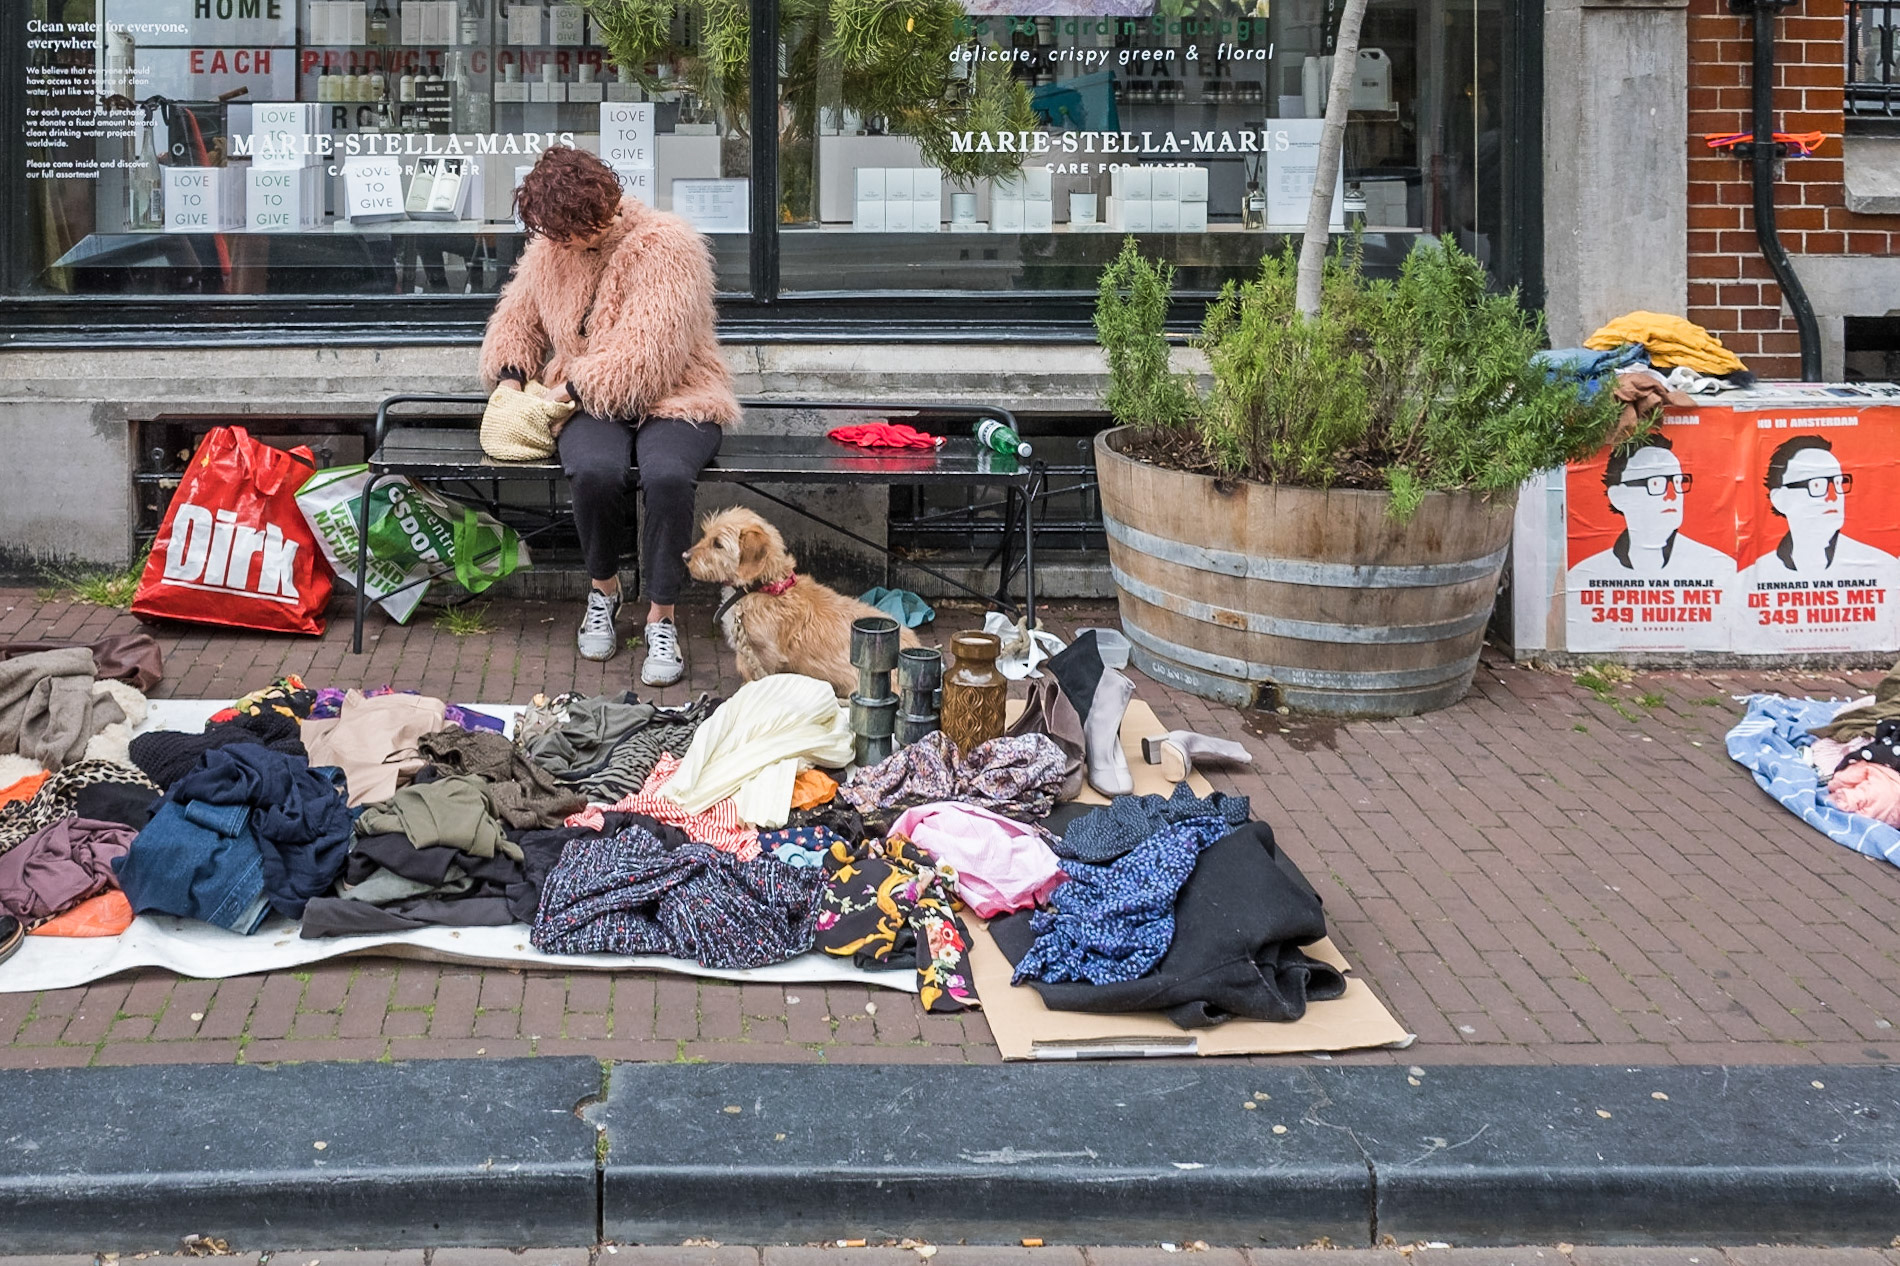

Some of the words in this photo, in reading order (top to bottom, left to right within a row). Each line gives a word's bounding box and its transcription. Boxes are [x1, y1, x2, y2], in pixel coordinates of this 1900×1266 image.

[195, 0, 281, 19] HOME
[27, 20, 63, 32] Clean
[67, 21, 102, 32] water
[105, 20, 124, 32] for
[127, 22, 188, 37] everyone,
[1005, 16, 1037, 36] 96
[1051, 14, 1136, 36] Jardin
[1152, 15, 1266, 41] Sauvage
[27, 37, 103, 52] everywhere.
[949, 45, 1037, 64] delicate,
[1049, 46, 1109, 65] crispy
[1119, 49, 1175, 65] green
[1186, 45, 1199, 61] &
[1217, 43, 1274, 61] floral
[190, 50, 271, 74] EACH
[302, 50, 441, 74] PRODUCT
[26, 66, 39, 74] We
[42, 66, 68, 74] believe
[71, 66, 86, 74] that
[88, 68, 122, 77] everyone
[125, 66, 150, 74] should
[26, 77, 45, 85] have
[74, 77, 82, 85] to
[118, 77, 127, 85] of
[129, 77, 149, 85] clean
[26, 88, 49, 97] water,
[51, 87, 66, 97] just
[68, 87, 81, 95] like
[26, 108, 39, 116] For
[41, 108, 59, 116] each
[62, 108, 91, 118] product
[94, 110, 107, 118] you
[109, 108, 146, 118] purchase,
[261, 111, 296, 123] LOVE
[610, 110, 645, 122] LOVE
[39, 118, 66, 126] donate
[76, 118, 95, 126] fixed
[127, 119, 157, 127] towards
[26, 129, 47, 137] clean
[49, 129, 81, 138] drinking
[107, 129, 136, 138] projects
[618, 129, 637, 141] TO
[26, 139, 68, 147] worldwide.
[232, 133, 576, 155] MARIE-STELLA-MARIS
[950, 131, 1290, 153] MARIE-STELLA-MARIS
[262, 149, 295, 160] GIVE
[611, 148, 644, 160] GIVE
[26, 160, 50, 168] Please
[75, 160, 98, 168] inside
[100, 160, 115, 168] and
[117, 160, 149, 168] discover
[1045, 163, 1089, 174] CARE
[1099, 163, 1131, 174] FOR
[41, 170, 54, 178] full
[56, 170, 99, 178] assortment!
[174, 176, 209, 187] LOVE
[255, 176, 290, 187] LOVE
[617, 175, 645, 187] OVE
[365, 183, 384, 193] TO
[183, 194, 201, 206] TO
[264, 195, 282, 206] TO
[360, 198, 393, 209] GIVE
[175, 214, 208, 225] GIVE
[256, 214, 289, 225] GIVE
[1790, 416, 1858, 428] AMSTERDAM
[163, 503, 299, 598] Dirk
[1589, 580, 1644, 588] BERNHARD
[1650, 580, 1669, 588] VAN
[1674, 580, 1714, 588] ORANJE
[1813, 580, 1833, 588] VAN
[1838, 579, 1877, 588] ORANJE
[1581, 590, 1604, 605] DE
[1613, 590, 1674, 605] PRINS
[1683, 590, 1723, 605] MET
[1748, 593, 1770, 608] DE
[1778, 591, 1839, 607] PRINS
[1847, 589, 1886, 604] MET
[1592, 608, 1633, 623] 349
[1642, 608, 1711, 622] HUIZEN
[1759, 609, 1798, 625] 349
[1807, 607, 1876, 623] HUIZEN
